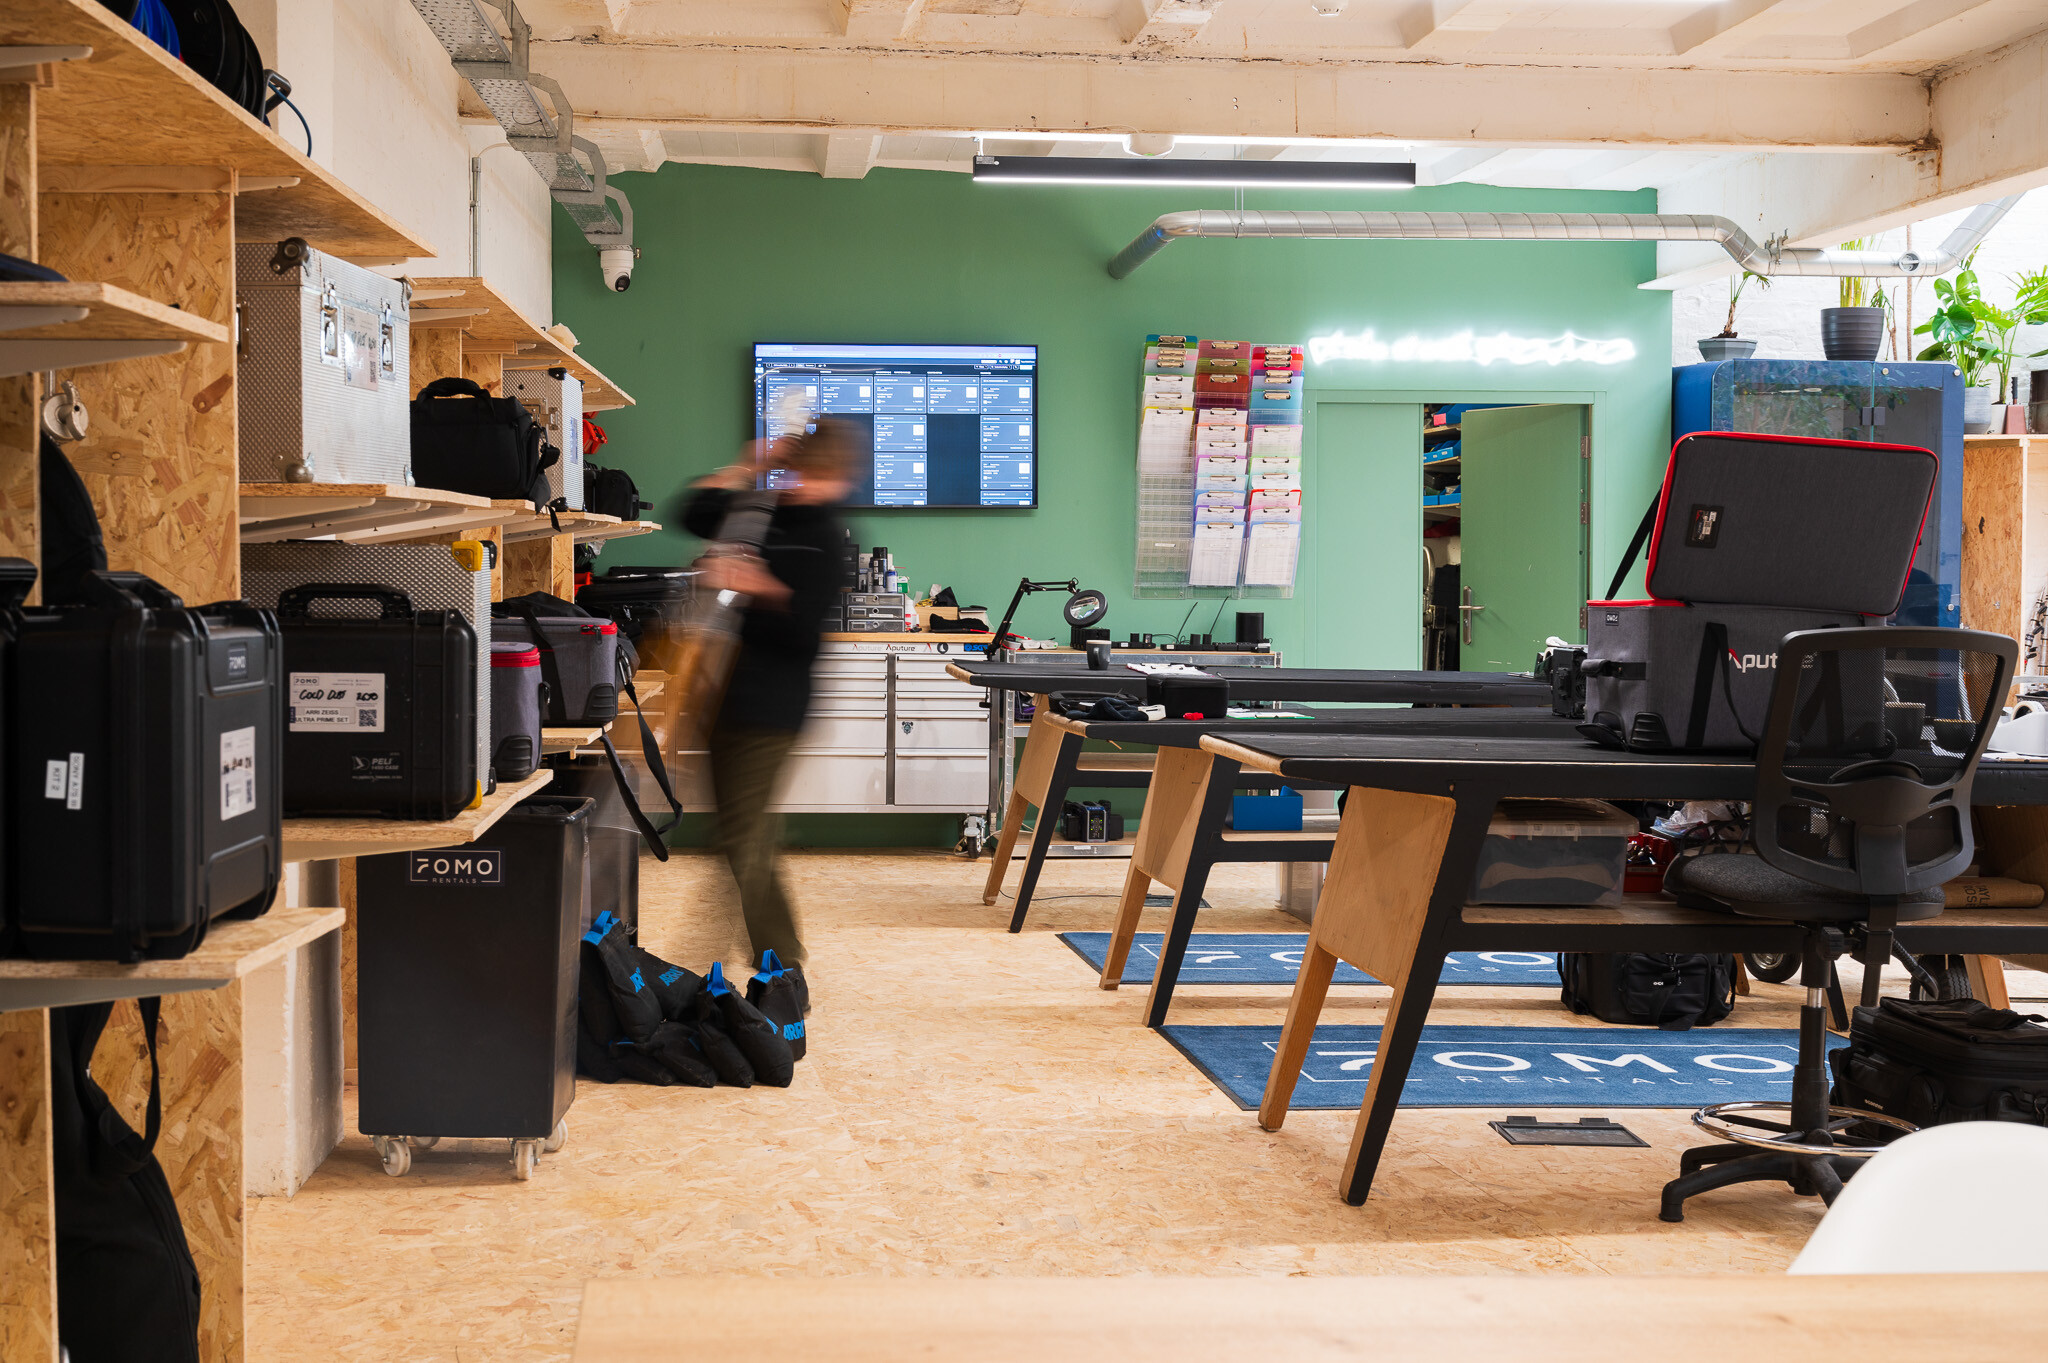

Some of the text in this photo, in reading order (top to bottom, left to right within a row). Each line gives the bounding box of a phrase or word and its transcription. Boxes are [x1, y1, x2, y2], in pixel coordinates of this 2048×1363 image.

[885, 643, 916, 652] Aputure
[416, 858, 493, 875] FOMO
[1456, 1076, 1733, 1086] RENTALS
